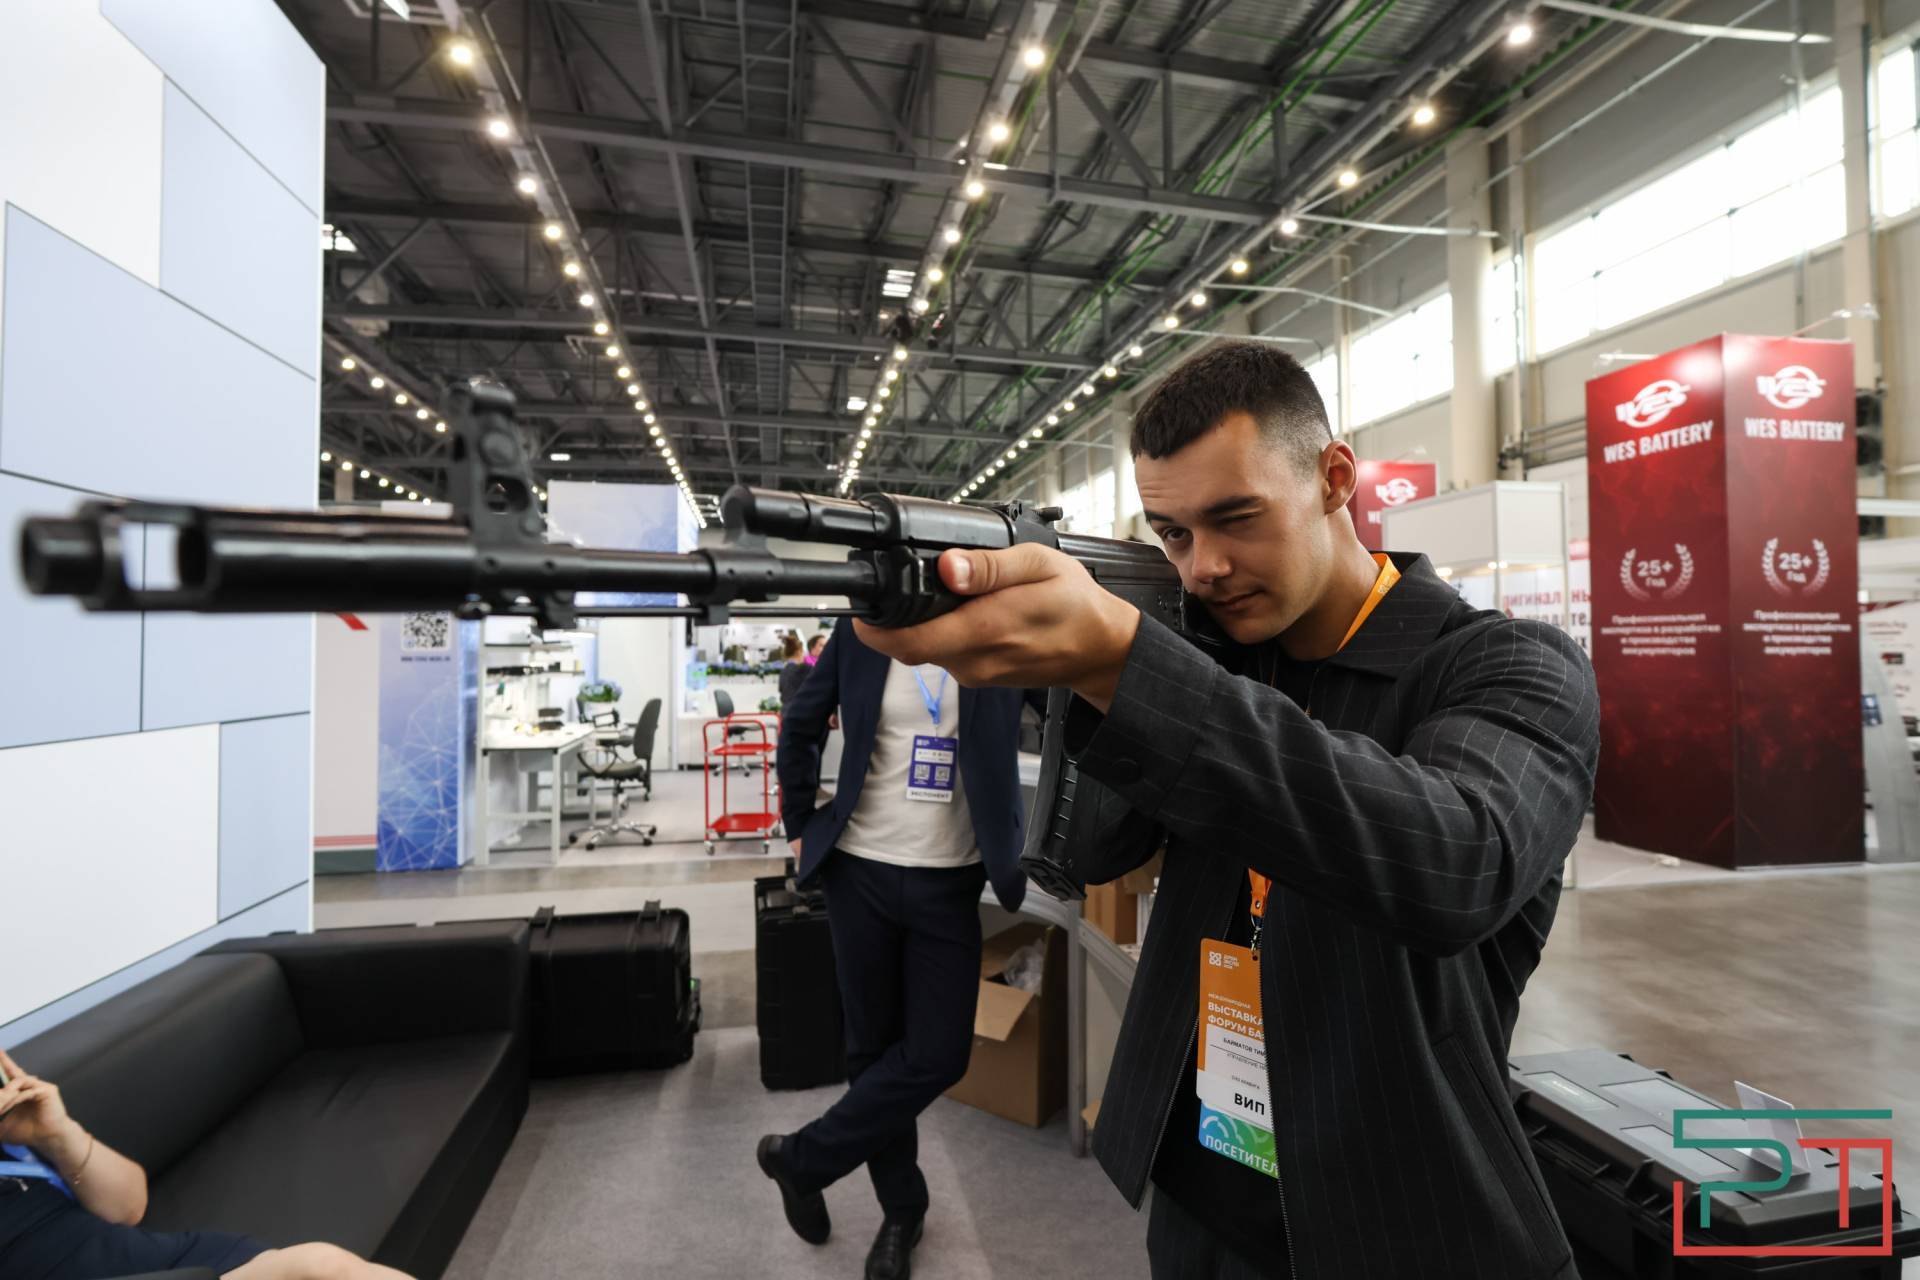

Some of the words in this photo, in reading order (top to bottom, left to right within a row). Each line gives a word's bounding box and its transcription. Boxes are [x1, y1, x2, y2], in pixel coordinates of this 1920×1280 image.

[1744, 417, 1777, 438] WES
[1780, 420, 1845, 441] BATTERY
[1603, 439, 1636, 463] WES
[1639, 421, 1714, 456] BATTERY
[1636, 559, 1674, 577] 25+
[1778, 552, 1813, 570] 25+
[1207, 1014, 1247, 1034] ФОРУМ
[1247, 1027, 1264, 1040] БА
[1234, 1092, 1265, 1116] ВИП
[1205, 1135, 1279, 1177] ПОСЕТИТЕЛ
